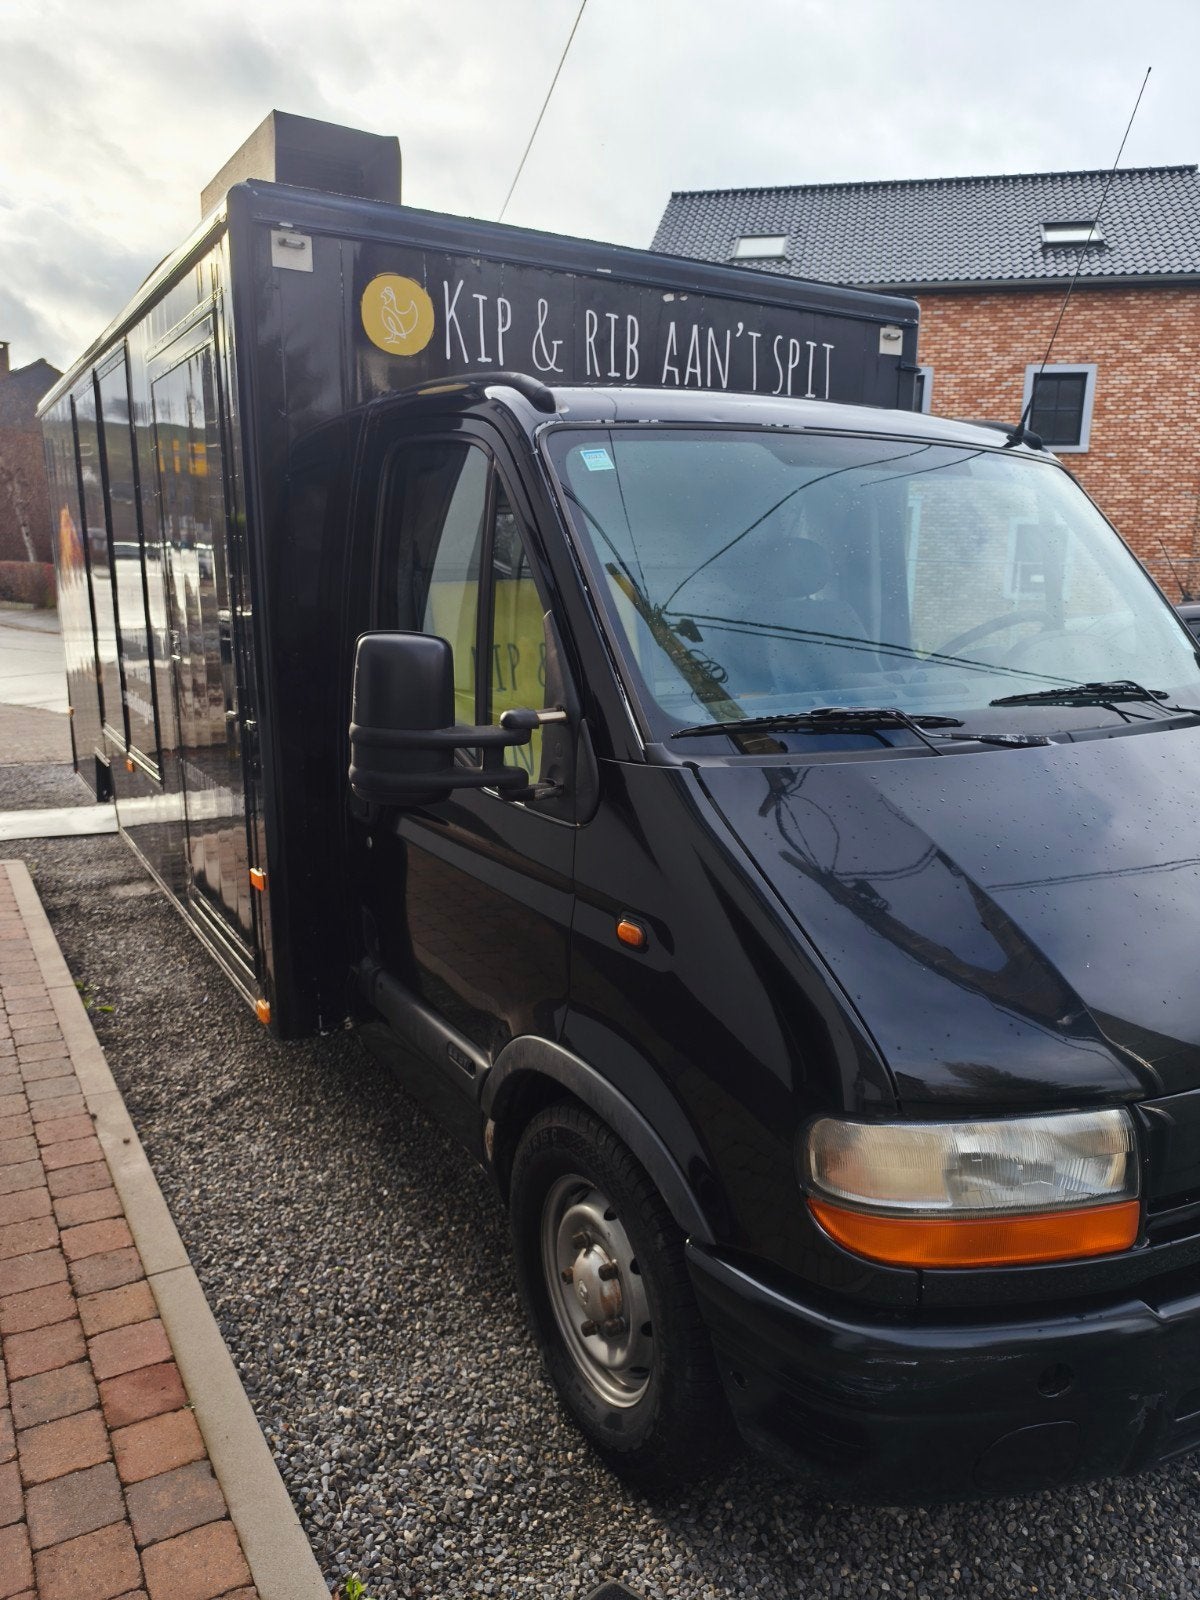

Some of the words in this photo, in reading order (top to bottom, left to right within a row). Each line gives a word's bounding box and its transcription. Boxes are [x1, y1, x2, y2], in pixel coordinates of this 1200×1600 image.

[443, 279, 512, 366] KIP
[532, 298, 564, 373] &
[585, 309, 640, 381] RIB
[772, 334, 835, 400] SPIT
